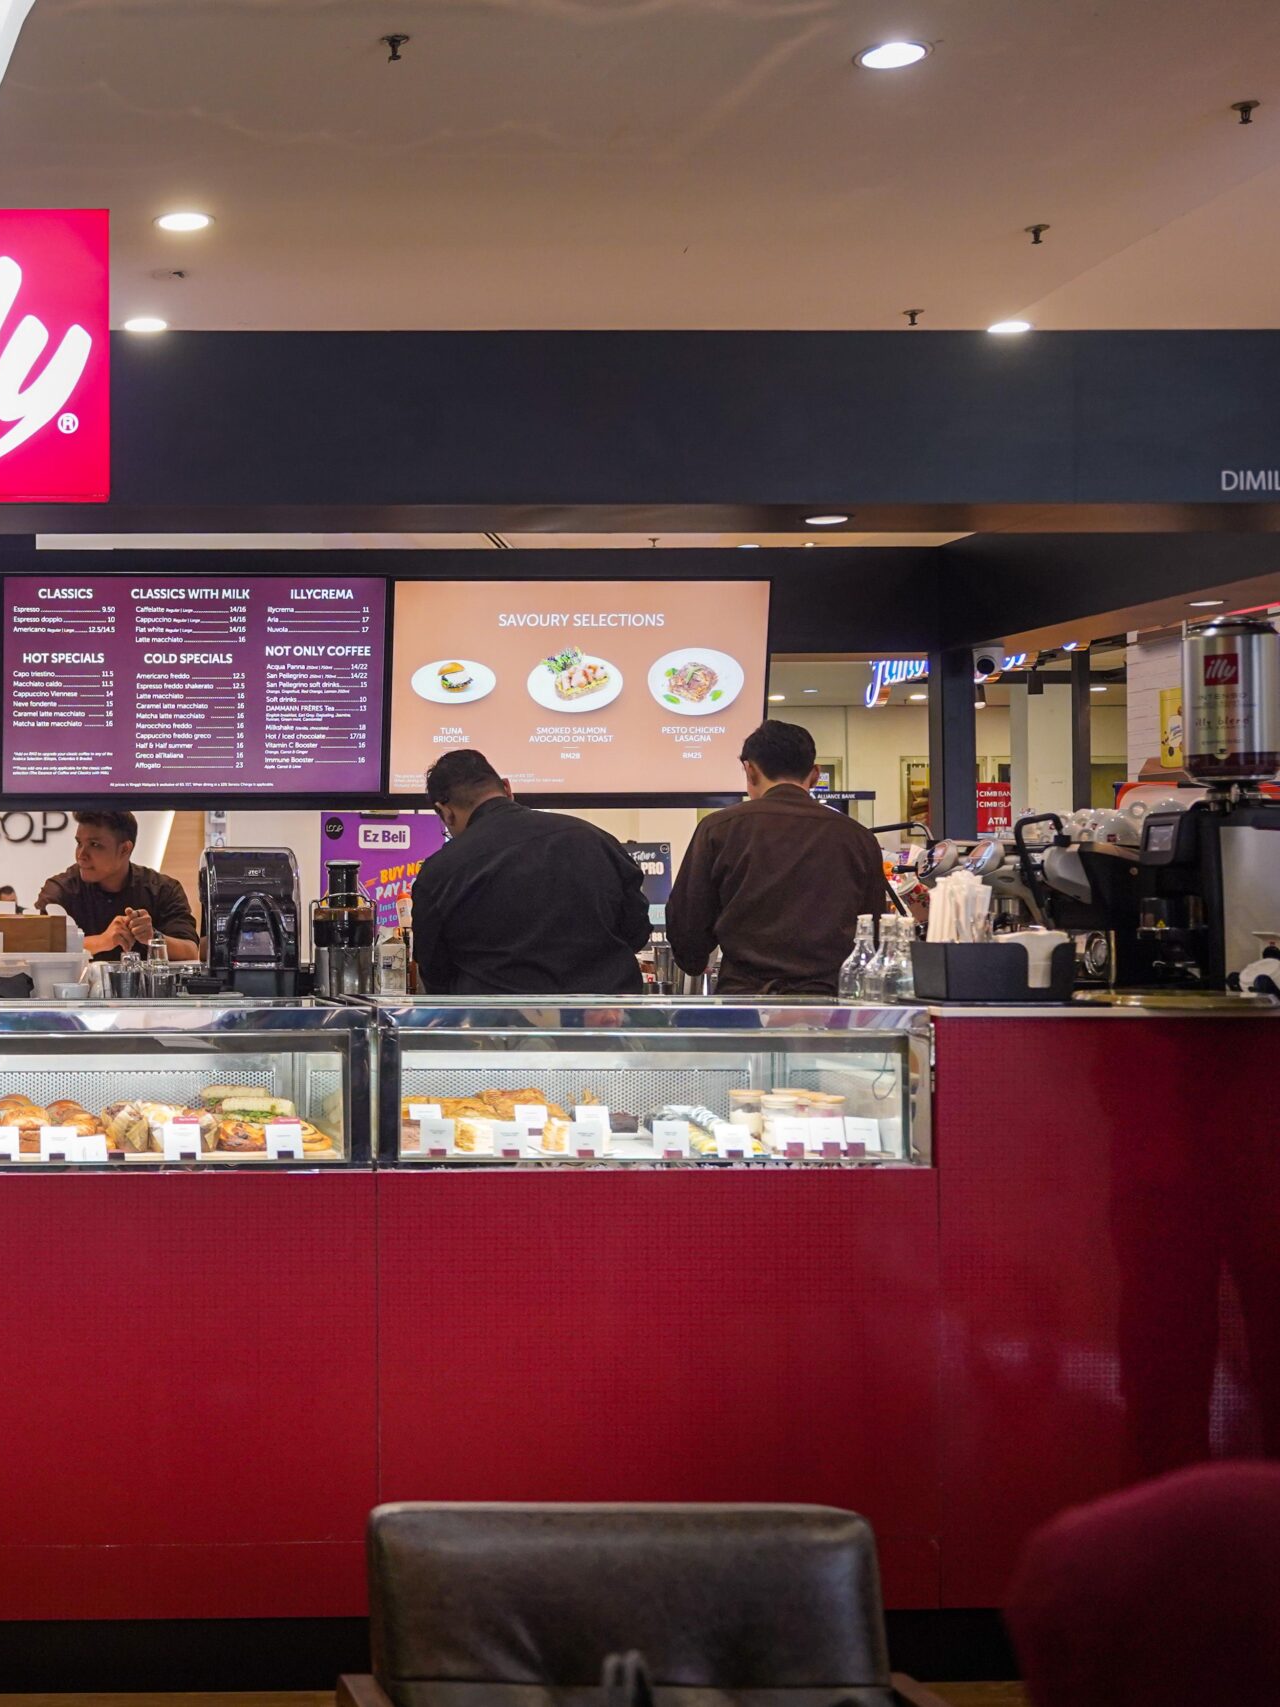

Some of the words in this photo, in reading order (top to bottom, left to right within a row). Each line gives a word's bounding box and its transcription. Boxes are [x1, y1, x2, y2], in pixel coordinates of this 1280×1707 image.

[38, 589, 93, 599] CLASSICS
[131, 589, 185, 599] CLASSICS
[188, 589, 219, 599] WITH
[222, 589, 250, 599] MILK
[290, 589, 353, 599] ILLYCREMA
[499, 614, 570, 627] SAVOURY
[573, 614, 664, 627] SELECTIONS
[266, 646, 291, 656] NOT
[293, 646, 326, 656] ONLY
[327, 646, 371, 656] COFFEE
[23, 653, 49, 663] HOT
[51, 653, 104, 663] SPECIALS
[144, 653, 177, 664] COLD
[180, 653, 232, 664] SPECIALS
[1206, 659, 1236, 682] illy
[364, 830, 378, 842] Ez
[382, 831, 406, 842] Beli
[641, 862, 664, 874] PRO
[380, 865, 404, 883] BUY
[376, 882, 400, 900] PAY
